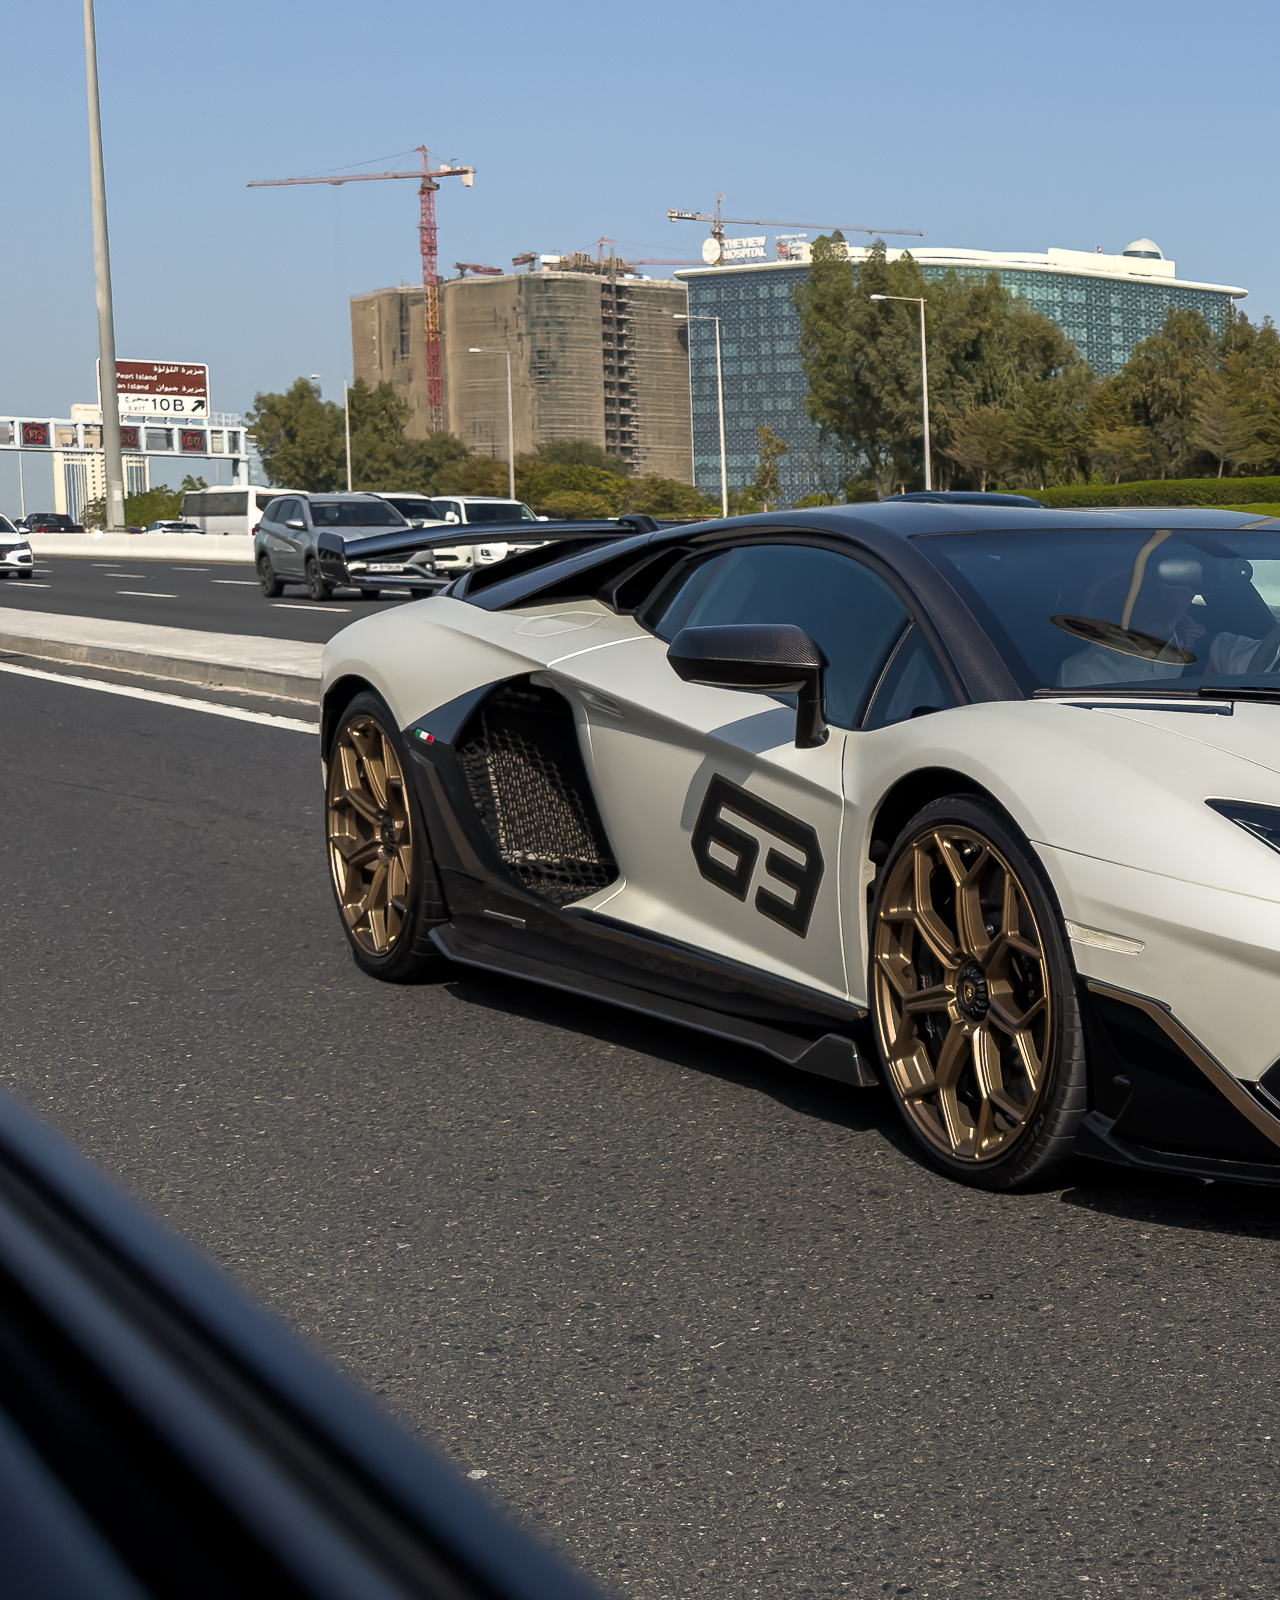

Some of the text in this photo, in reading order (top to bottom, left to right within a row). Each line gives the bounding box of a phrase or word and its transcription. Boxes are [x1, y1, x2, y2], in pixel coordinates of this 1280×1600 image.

[741, 236, 767, 248] VIEW
[723, 246, 768, 260] HOSPITAL
[135, 373, 158, 381] Island
[151, 398, 184, 412] 10B
[690, 772, 825, 939] 63
